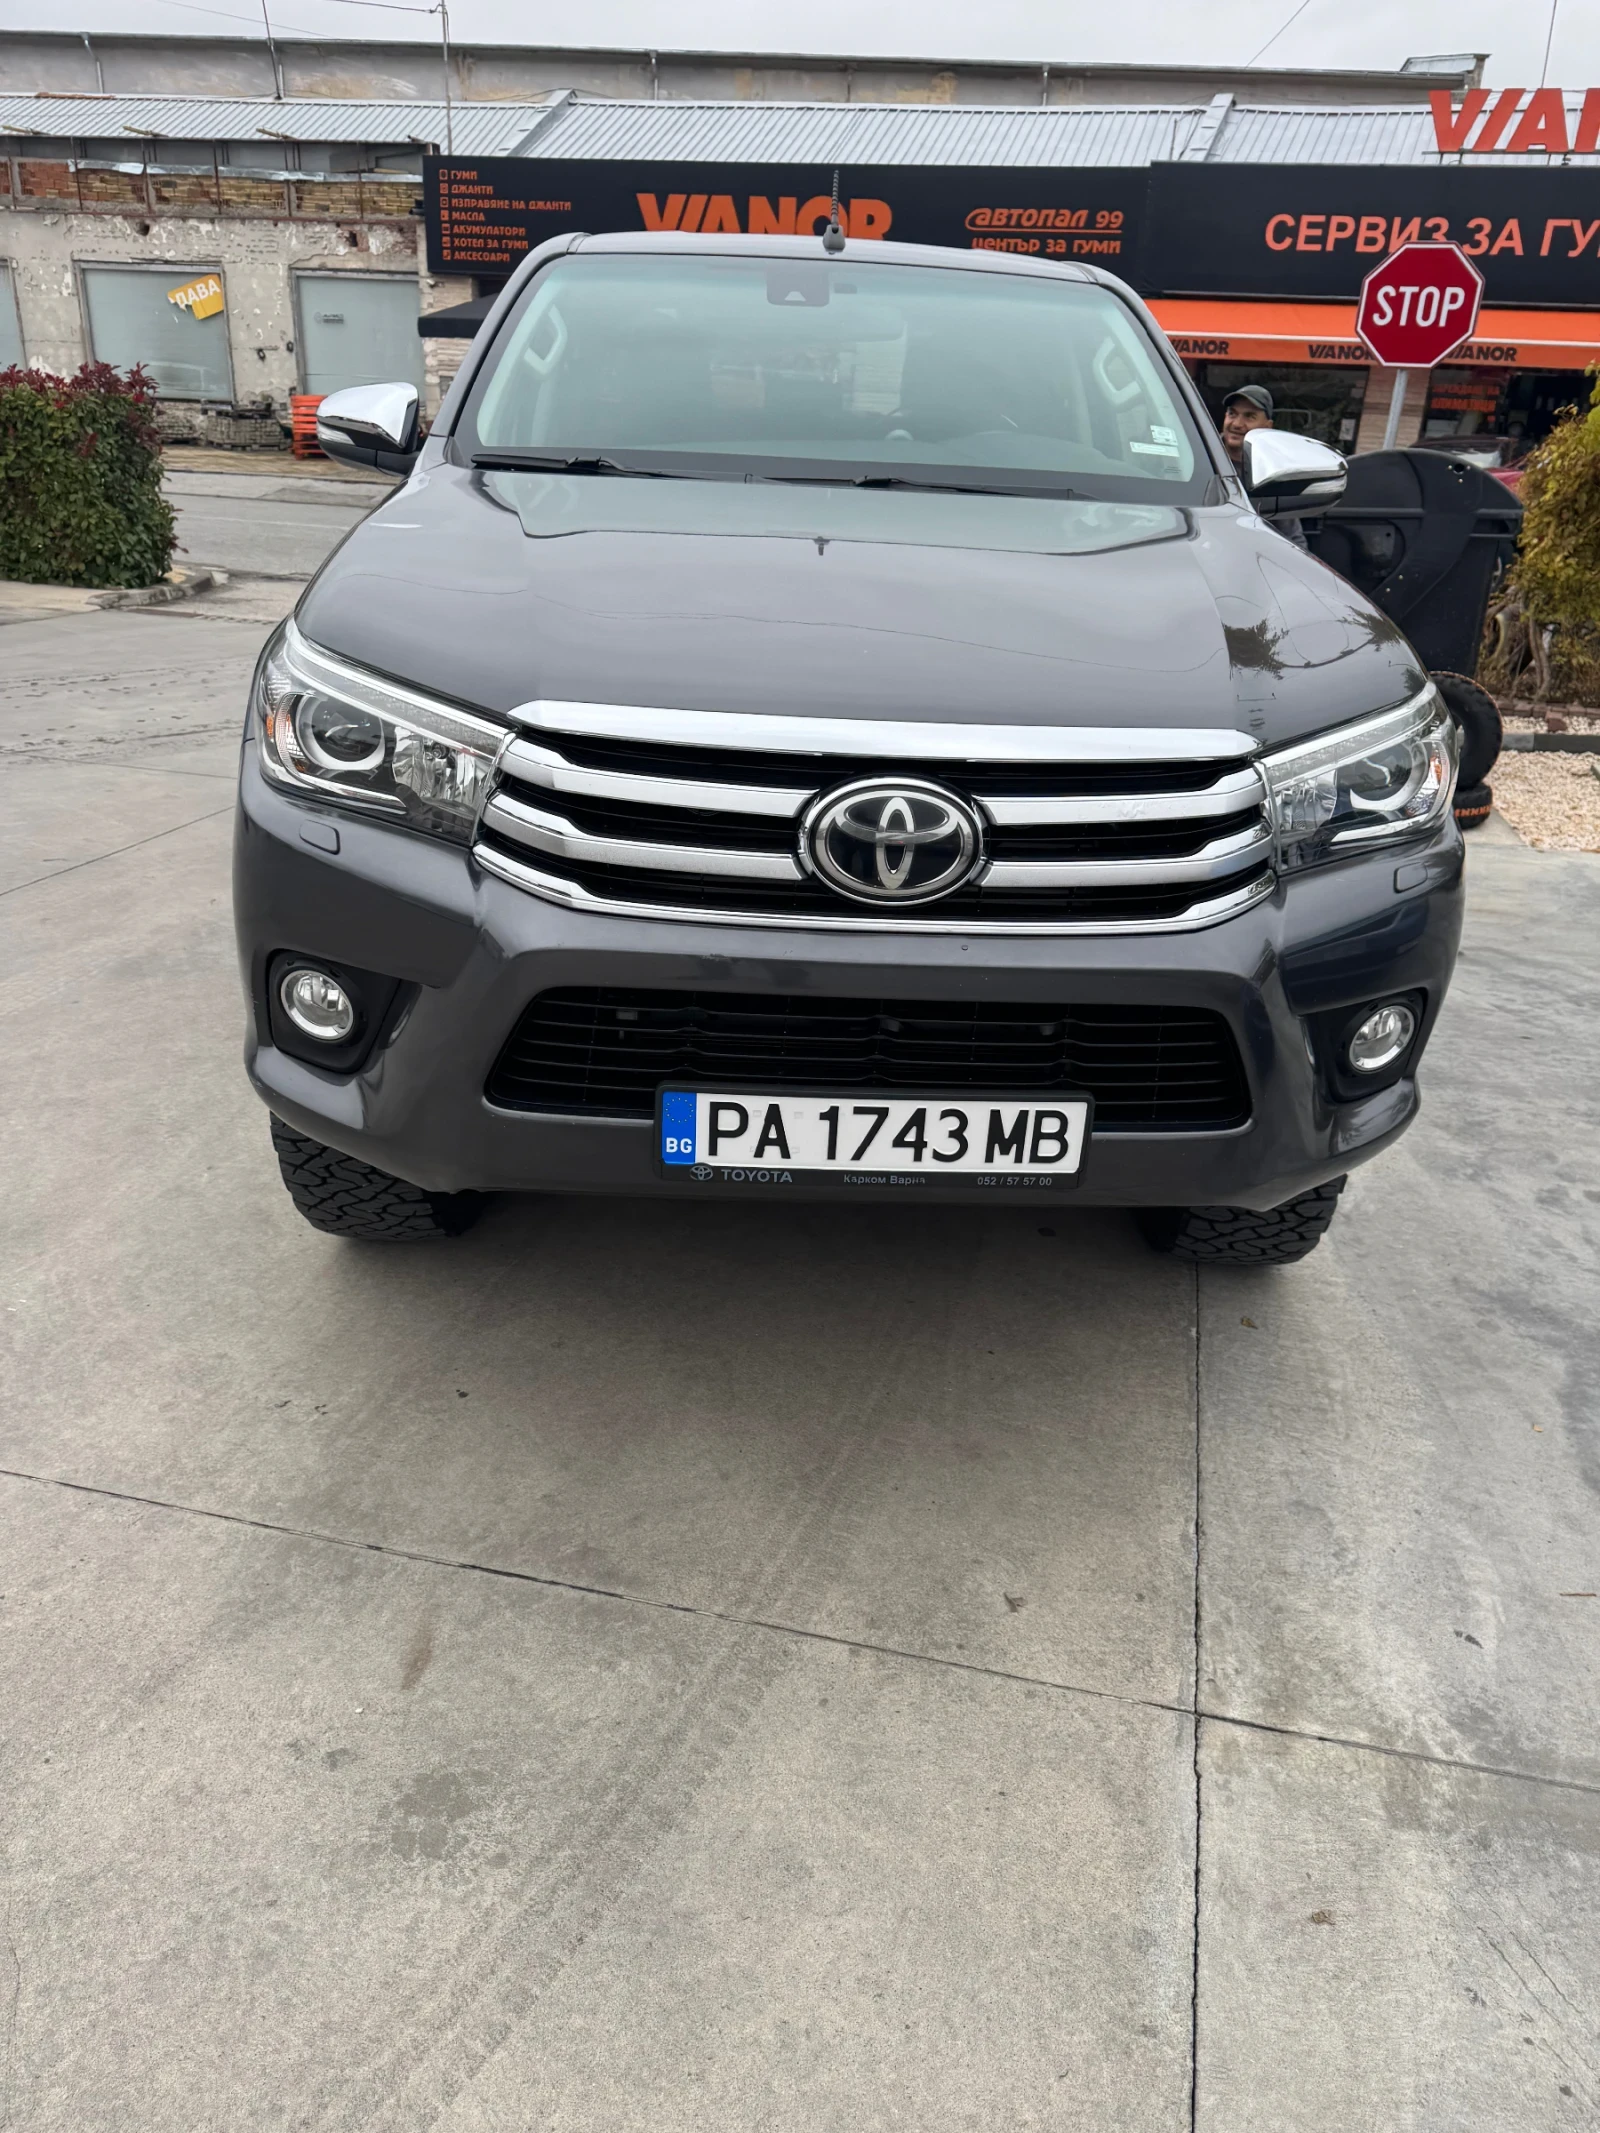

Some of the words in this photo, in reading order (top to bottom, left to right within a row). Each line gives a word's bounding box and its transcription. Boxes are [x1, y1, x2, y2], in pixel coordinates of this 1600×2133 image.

[451, 170, 477, 180] ГУМИ
[451, 185, 493, 194] ДЖАНТИ
[452, 198, 509, 209] ИЗПРАВЯНЕ
[512, 200, 525, 209] НА
[528, 201, 571, 211] ДЖАНТИ
[452, 211, 485, 221] МАСЛА
[636, 193, 892, 240] VIANOR
[1095, 210, 1124, 228] 99
[453, 225, 526, 236] АКУМУЛАТОРИ
[1265, 213, 1449, 253] СЕРВИЗ
[1463, 218, 1523, 256] ЗА
[1540, 218, 1600, 258] ГУ
[454, 238, 484, 248] ХОТЕЛ
[487, 239, 499, 248] ЗА
[502, 240, 528, 249] ГУМИ
[972, 237, 1040, 252] център
[1046, 239, 1067, 252] за
[1073, 239, 1122, 254] гуми
[454, 251, 510, 261] АКСЕСОАРИ
[1372, 285, 1465, 328] STOP
[708, 1101, 791, 1159] PA
[819, 1105, 969, 1163] 1743
[984, 1108, 1069, 1165] MB
[666, 1137, 693, 1154] BG
[721, 1169, 793, 1184] TOYOTA
[843, 1174, 887, 1186] Карком
[977, 1177, 998, 1187] 052
[1006, 1178, 1021, 1187] 57
[1023, 1178, 1038, 1187] 57
[1038, 1178, 1053, 1188] 00
